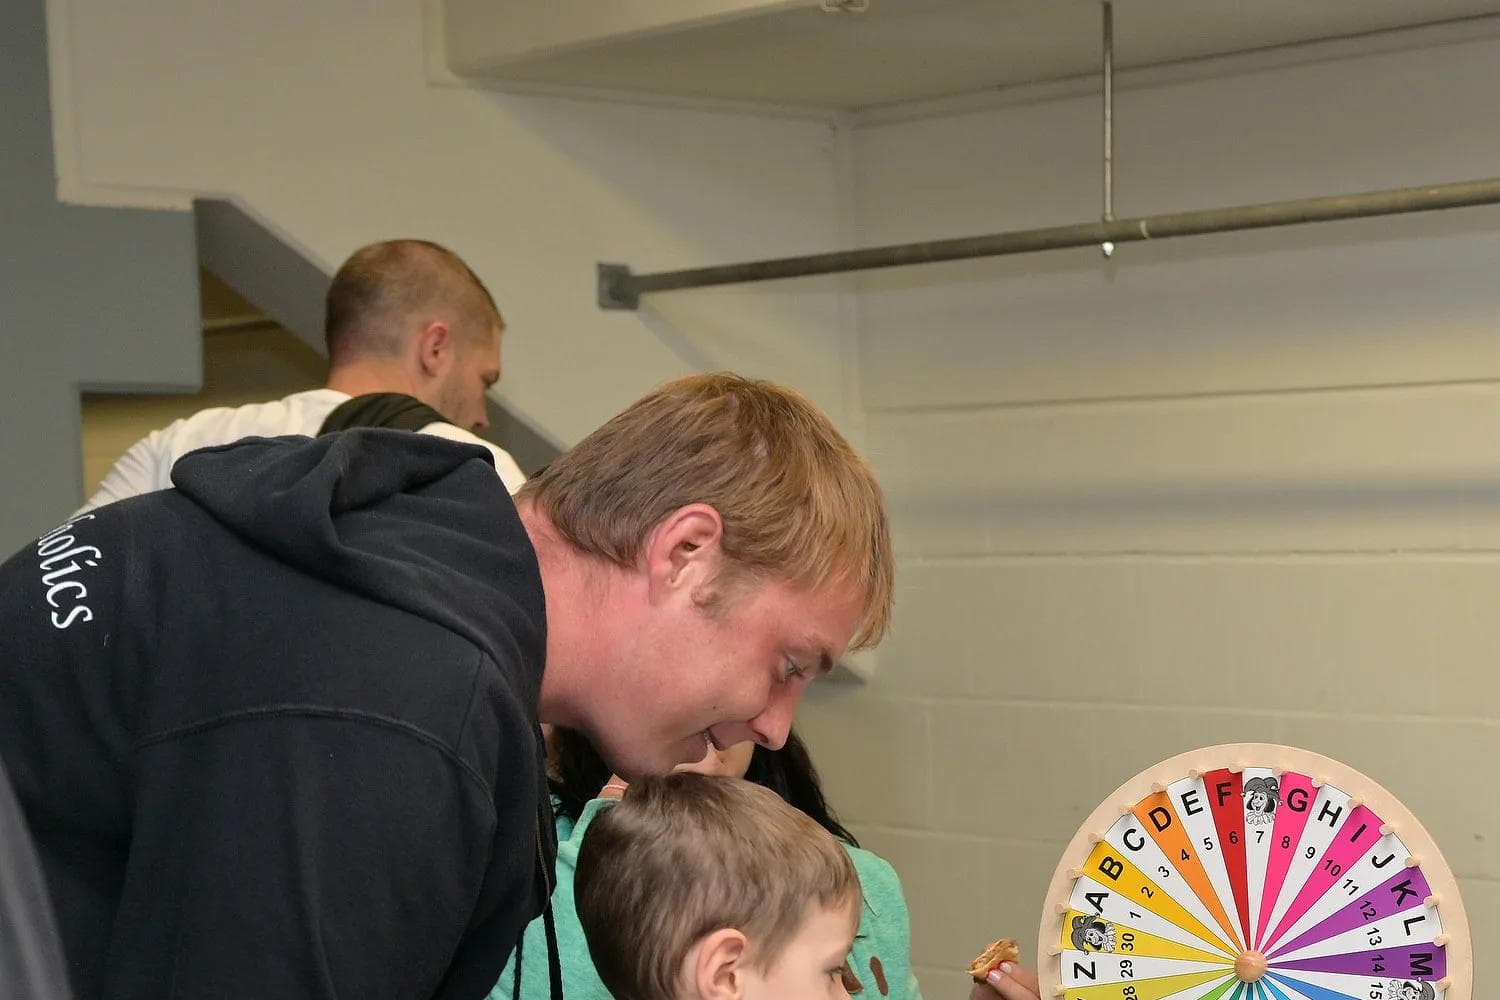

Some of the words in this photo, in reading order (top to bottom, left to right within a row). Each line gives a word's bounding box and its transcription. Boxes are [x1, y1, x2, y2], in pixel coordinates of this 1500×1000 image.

[1181, 790, 1203, 816] E
[1217, 782, 1231, 806] F
[1288, 789, 1308, 812] G
[1148, 807, 1171, 832] D
[1318, 800, 1342, 827] H
[1123, 829, 1144, 851] C
[1229, 831, 1238, 845] 6
[1255, 831, 1264, 844] 7
[1282, 836, 1290, 848] 8
[1351, 824, 1366, 842] I
[1203, 837, 1213, 851] 5
[1306, 847, 1315, 859] 9
[1182, 849, 1190, 860] 4
[1372, 854, 1395, 868] J
[1099, 857, 1123, 880] B
[1158, 866, 1169, 877] 3
[1325, 859, 1342, 876] 10
[1142, 887, 1154, 898] 2
[1342, 879, 1359, 896] 11
[1391, 880, 1418, 906] K
[1085, 893, 1109, 913] A
[1360, 901, 1376, 919] 12
[1404, 916, 1425, 936] L
[1121, 933, 1134, 951] 30
[1368, 928, 1381, 946] 13
[1074, 962, 1096, 980] Z
[1120, 960, 1132, 978] 29
[1372, 955, 1385, 973] 14
[1410, 953, 1433, 976] M
[1369, 982, 1382, 1000] 15
